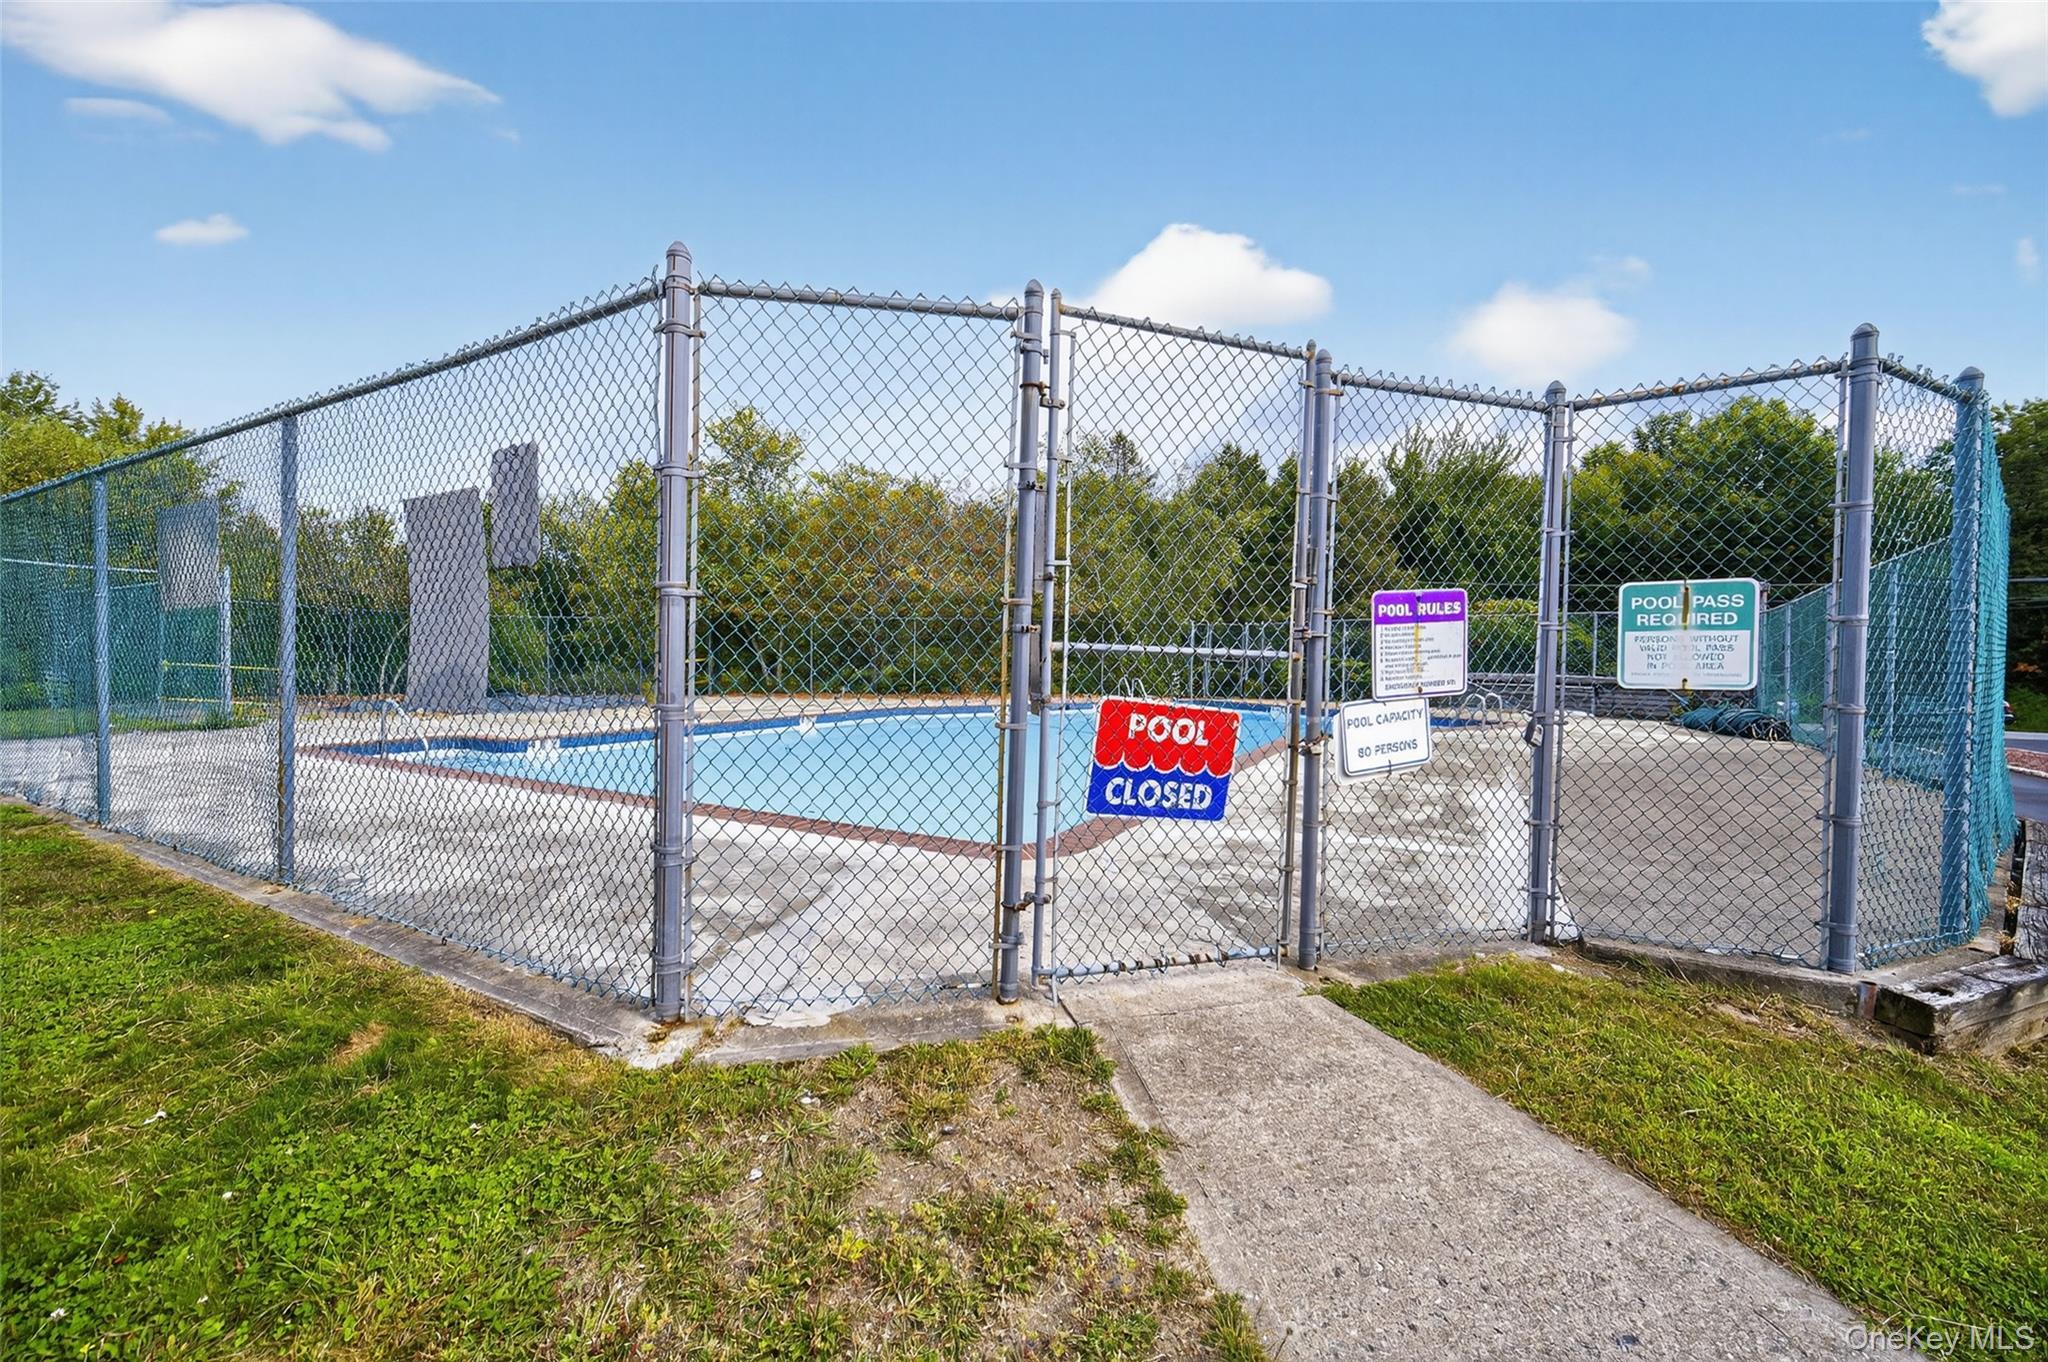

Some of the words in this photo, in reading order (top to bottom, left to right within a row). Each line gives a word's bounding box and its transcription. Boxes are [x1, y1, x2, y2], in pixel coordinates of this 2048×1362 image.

[1378, 603, 1413, 617] POOL
[1418, 601, 1462, 616] RULES
[1630, 597, 1684, 610] POOL
[1692, 594, 1745, 608] PASS
[1689, 634, 1739, 643] WITHOUT
[1705, 643, 1735, 652] PASS
[1646, 653, 1667, 661] NOT
[1695, 661, 1725, 670] AREA
[1347, 716, 1373, 729] POOL
[1376, 708, 1423, 725] CAPACITY
[1128, 713, 1209, 746] POOL
[1375, 738, 1418, 755] PERSONS
[1105, 777, 1213, 810] CLOSED
